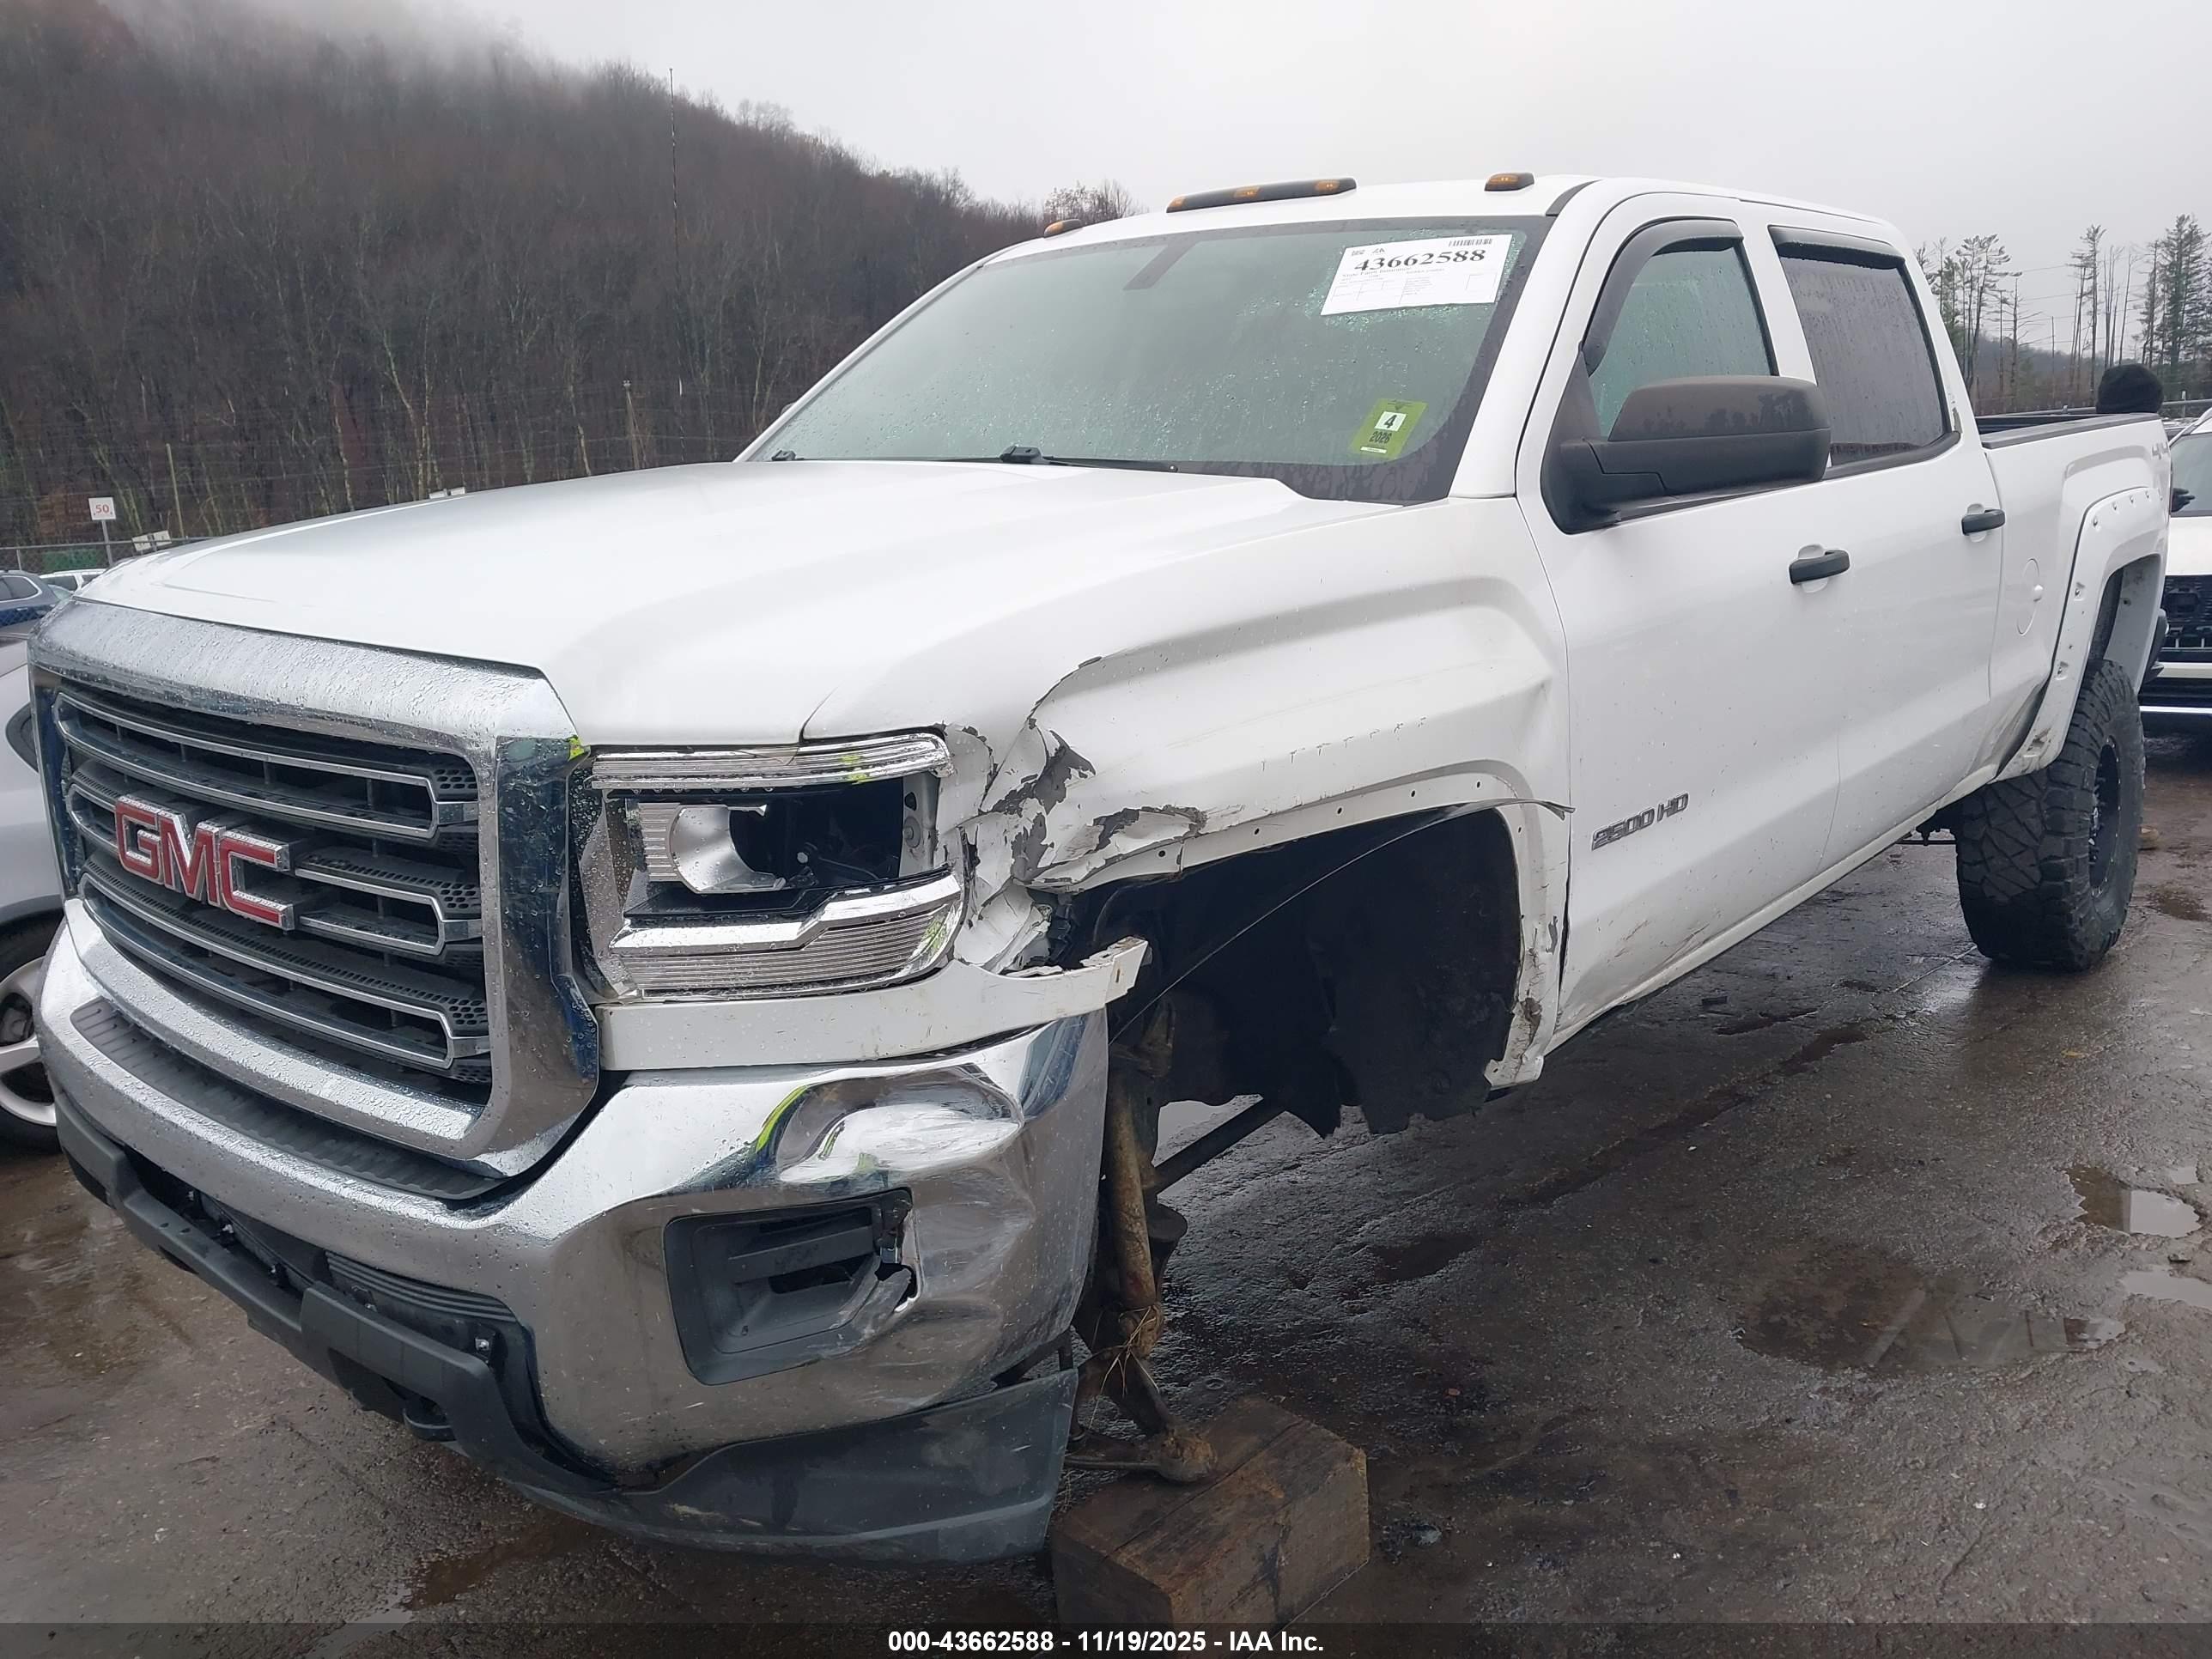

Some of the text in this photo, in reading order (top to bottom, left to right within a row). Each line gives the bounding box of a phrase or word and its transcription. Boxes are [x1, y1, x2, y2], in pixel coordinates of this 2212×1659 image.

[1354, 249, 1486, 271] 43662588
[1384, 415, 1397, 428] 4
[1369, 431, 1392, 444] 2026
[95, 504, 110, 514] 50
[1591, 793, 1689, 851] 2500 HD
[115, 795, 295, 930] GMC
